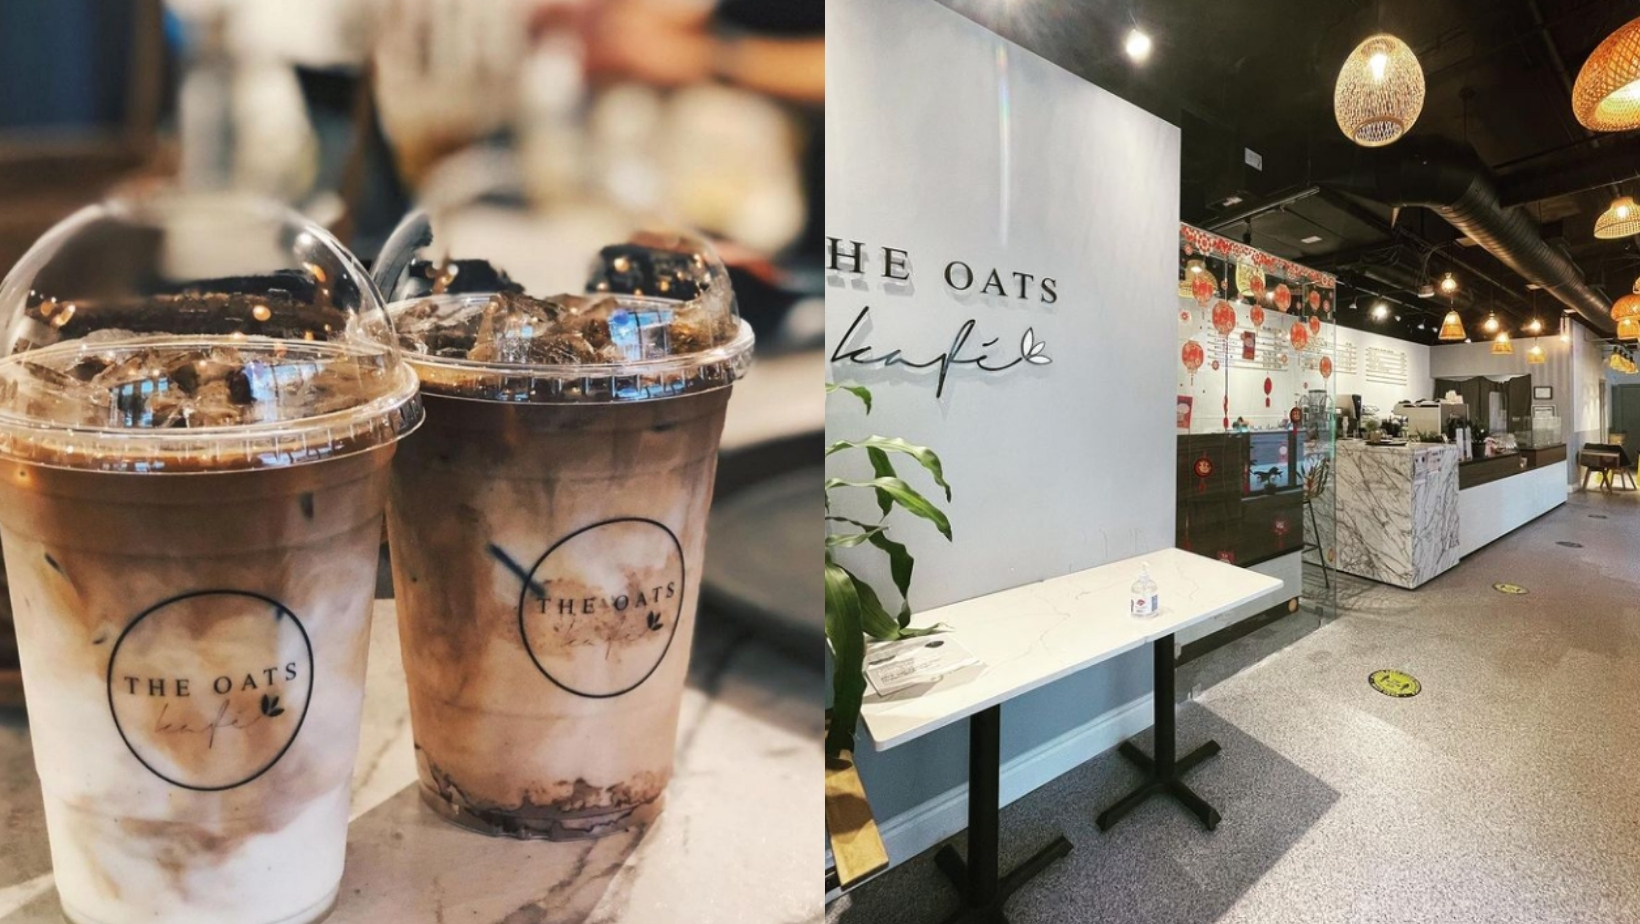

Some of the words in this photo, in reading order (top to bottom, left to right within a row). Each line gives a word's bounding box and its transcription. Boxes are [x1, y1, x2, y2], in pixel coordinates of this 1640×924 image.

[943, 260, 1058, 304] OATS
[536, 595, 596, 615] THE
[615, 581, 675, 611] OATS
[124, 676, 191, 697] THE
[213, 662, 298, 695] OATS
